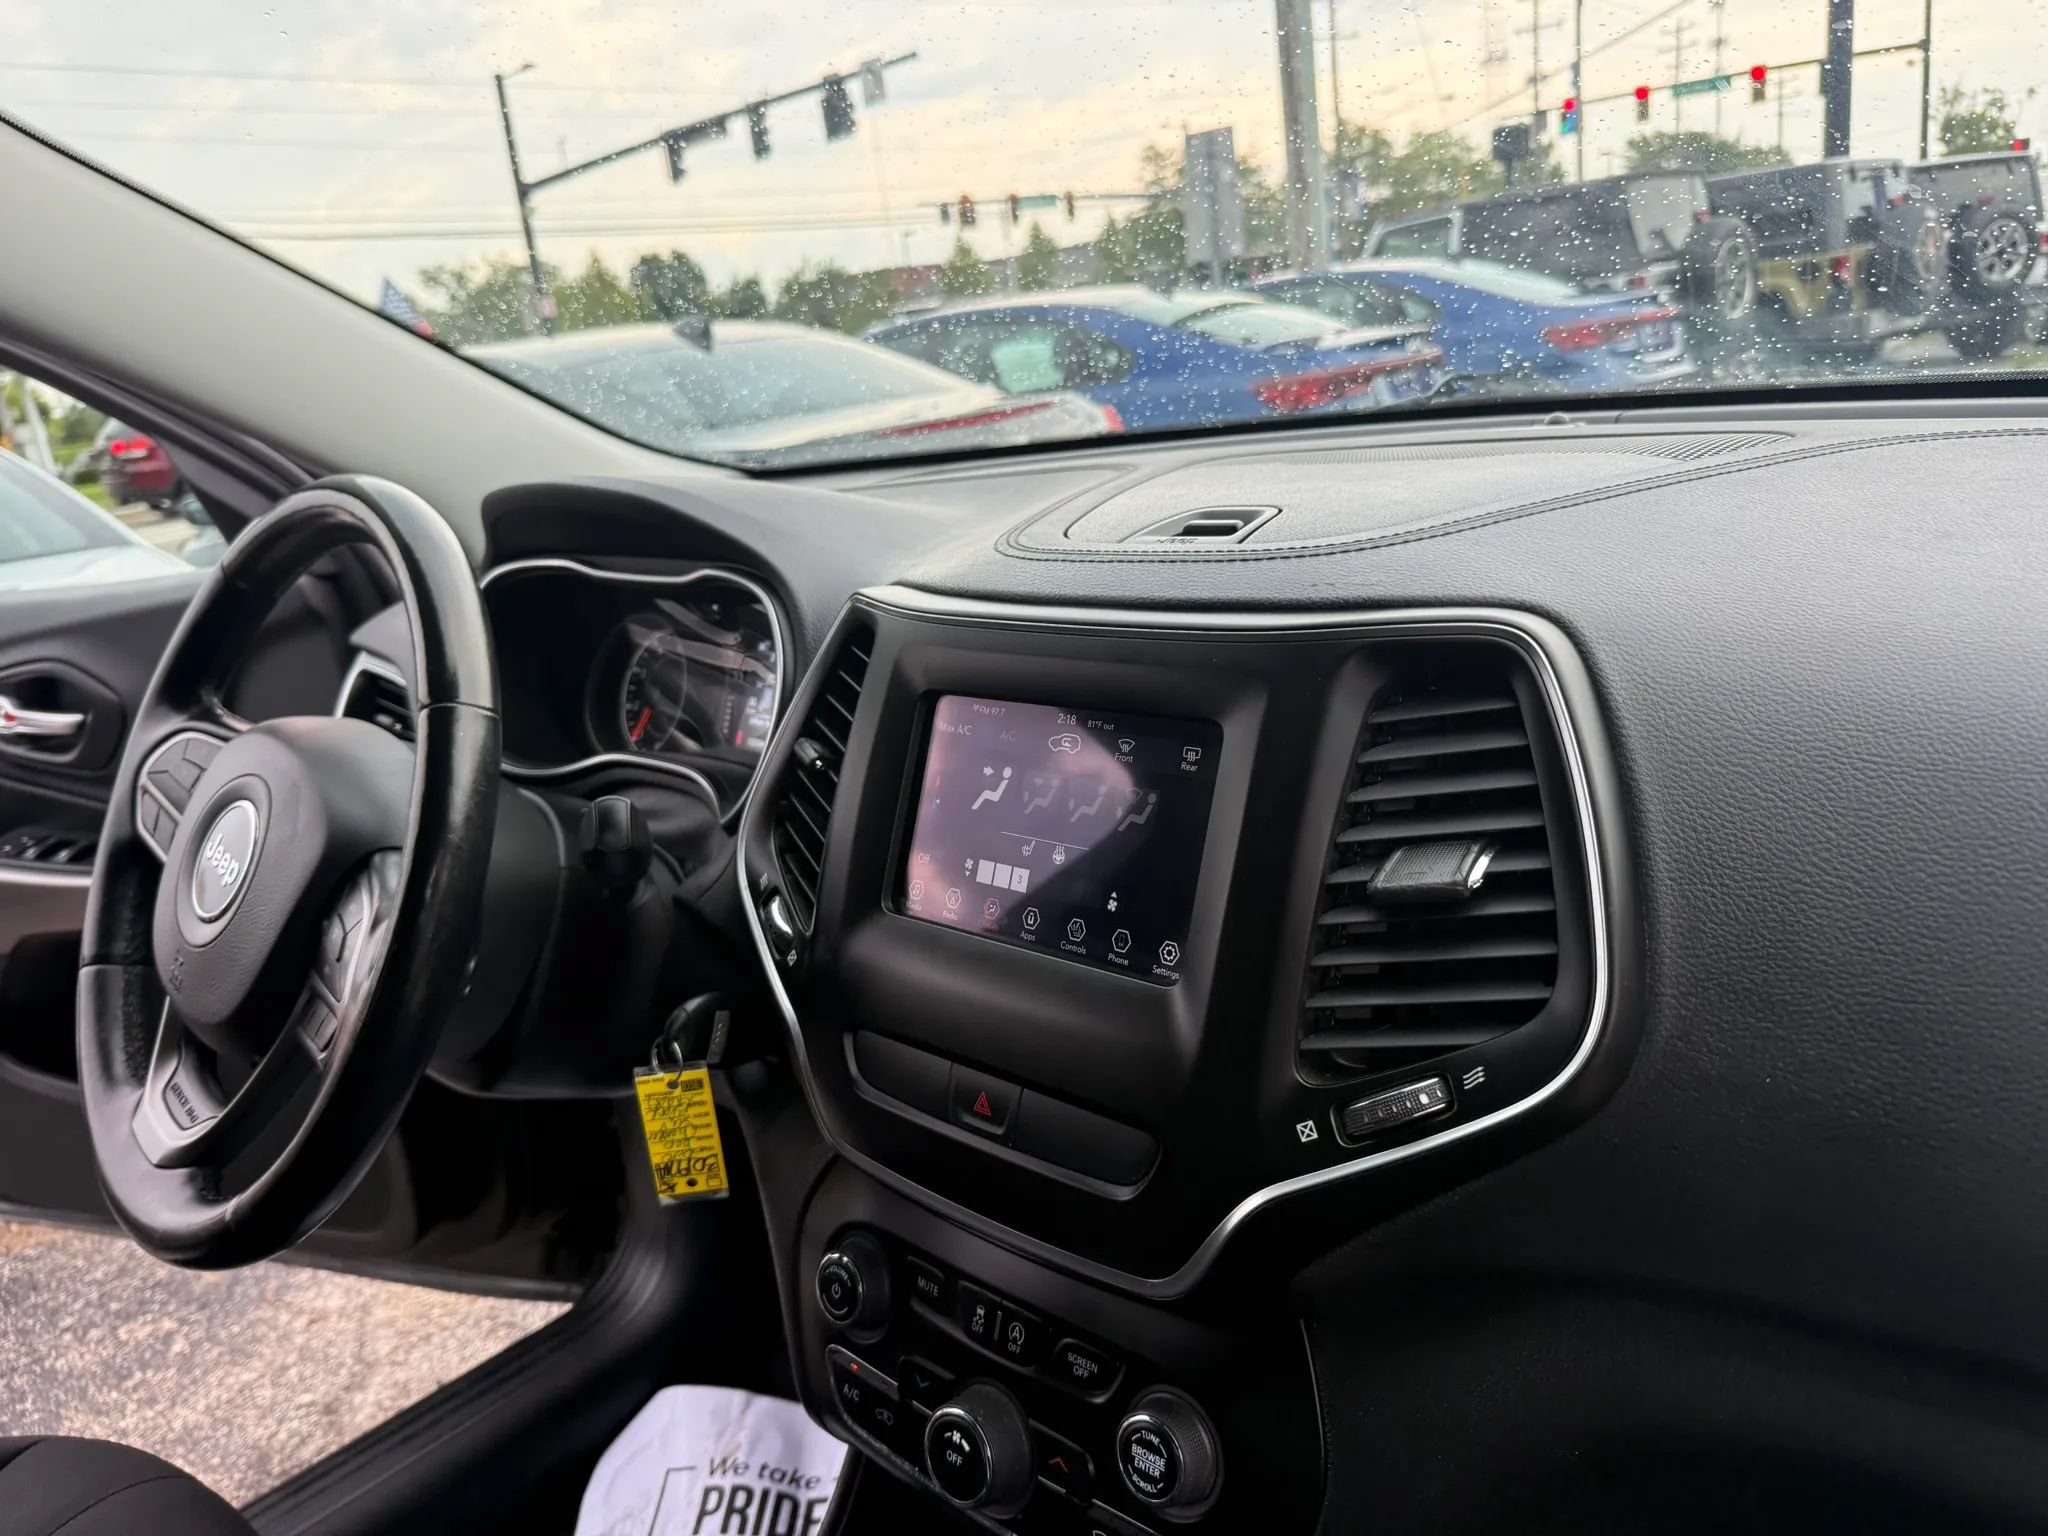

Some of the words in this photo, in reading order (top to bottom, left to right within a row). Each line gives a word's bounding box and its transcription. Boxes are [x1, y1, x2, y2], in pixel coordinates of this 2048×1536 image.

[1058, 713, 1077, 725] 2:18
[956, 725, 972, 736] A/C
[1104, 723, 1115, 731] out
[1115, 752, 1134, 764] Front
[1181, 761, 1198, 772] Rear
[206, 833, 239, 887] Jeep
[918, 853, 931, 864] Off
[1016, 874, 1023, 884] 3
[942, 909, 959, 921] Radio
[1020, 930, 1036, 942] Apps
[1060, 940, 1087, 955] Controls
[1107, 953, 1129, 966] Phone
[1152, 964, 1180, 980] Settings
[917, 1275, 939, 1297] MUTE
[971, 1321, 984, 1335] OFF
[1007, 1341, 1021, 1355] OFF
[1067, 1351, 1099, 1375] SCREEN
[1073, 1365, 1089, 1379] OFF
[842, 1383, 860, 1401] A/C
[1140, 1430, 1161, 1447] TUNE
[946, 1450, 963, 1467] OFF
[1131, 1442, 1166, 1469] BROWSE
[708, 1456, 750, 1478] We
[758, 1461, 822, 1492] take
[1134, 1457, 1161, 1480] ENTER
[1132, 1473, 1158, 1493] SCROLL
